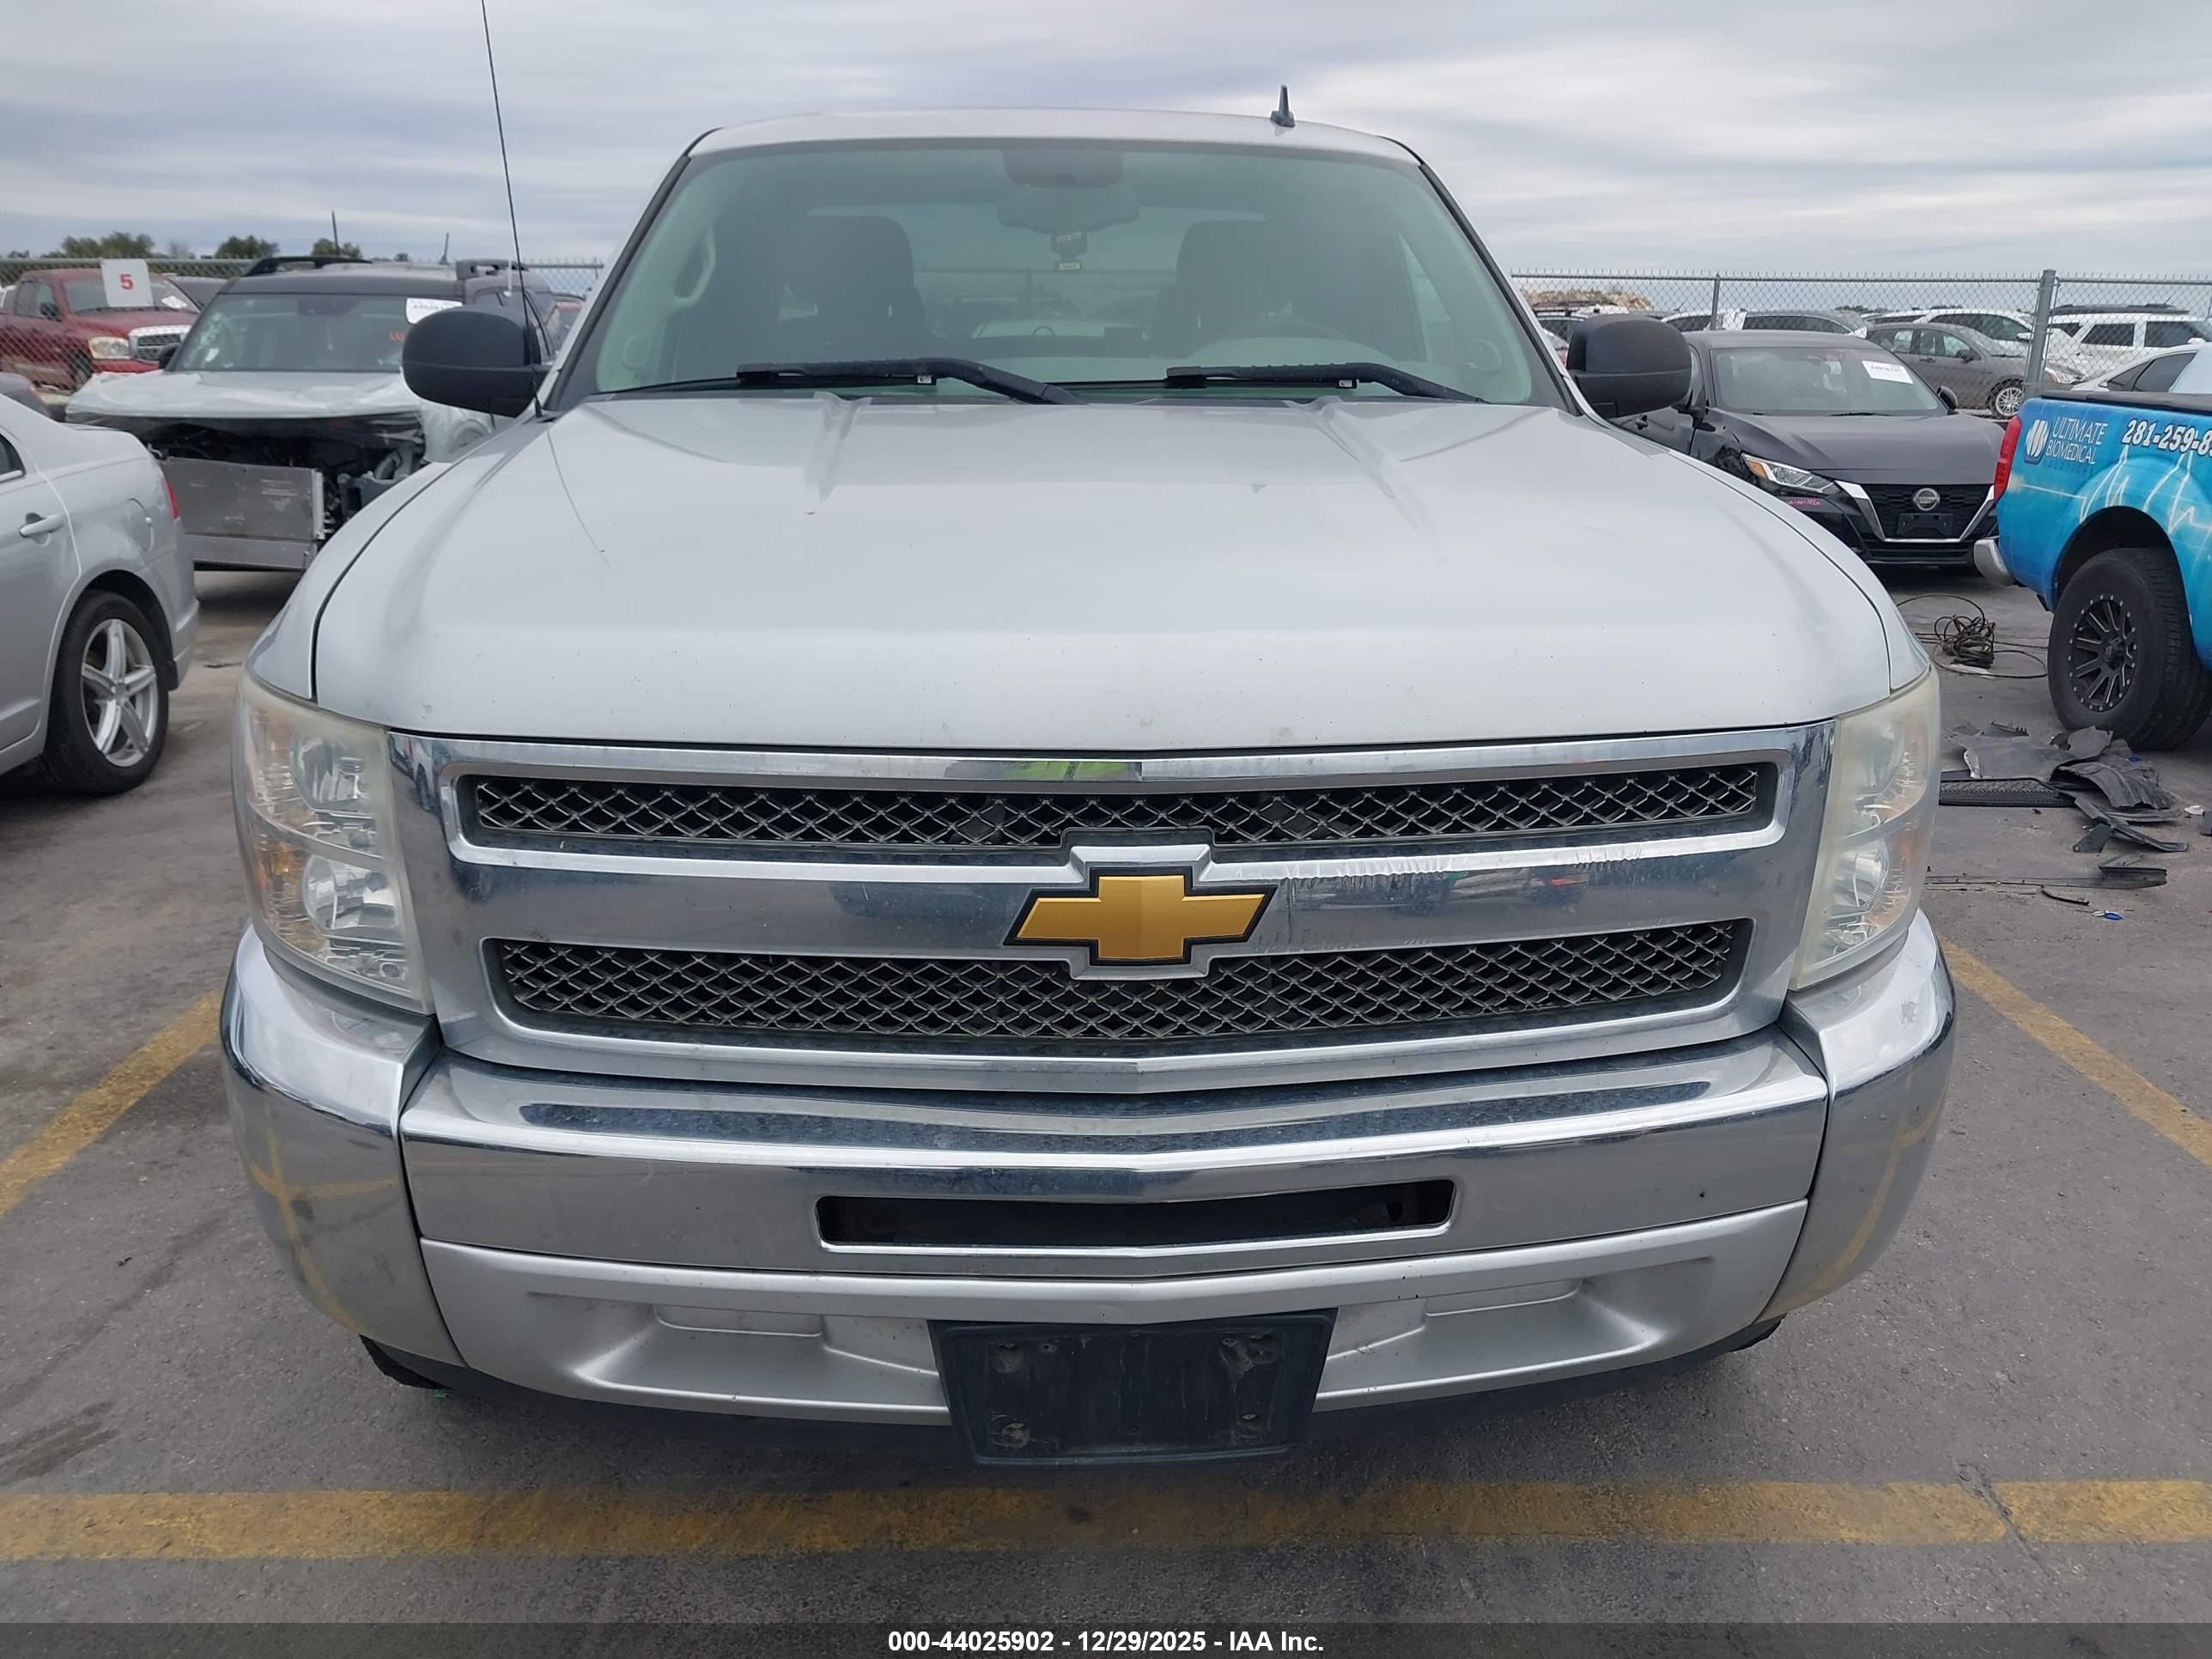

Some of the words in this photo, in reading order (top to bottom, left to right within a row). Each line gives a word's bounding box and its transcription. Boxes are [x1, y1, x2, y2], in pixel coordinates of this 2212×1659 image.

[119, 274, 133, 289] 5
[2052, 416, 2109, 445] ULTIMATE
[2122, 419, 2212, 457] 281-259-8
[2045, 439, 2097, 465] BIOMEDICAL
